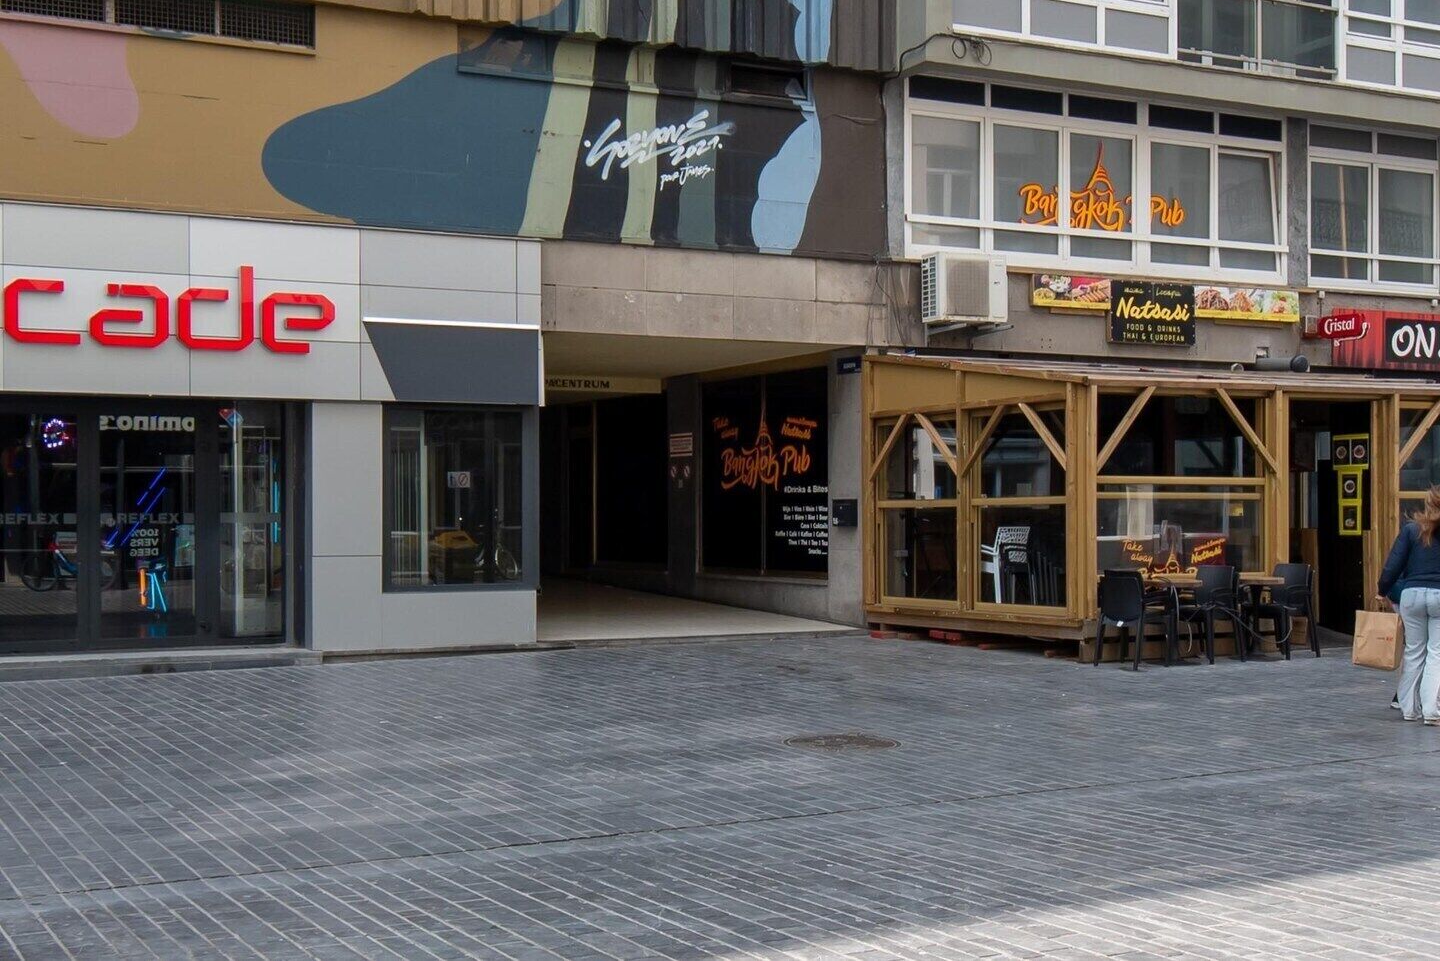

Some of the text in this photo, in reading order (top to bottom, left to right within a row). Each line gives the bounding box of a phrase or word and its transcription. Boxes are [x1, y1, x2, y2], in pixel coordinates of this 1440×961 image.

[3, 266, 336, 354] cade
[1116, 296, 1190, 322] Natsasi
[1126, 323, 1145, 331] FOOD
[1157, 325, 1181, 333] DRINKS
[1324, 317, 1355, 335] Cristal
[1149, 333, 1185, 342] EUROPEAN
[1391, 323, 1436, 358] ON
[721, 444, 812, 492] Bangkok Pub
[117, 512, 180, 525] REFLEX
[1122, 539, 1144, 552] Take
[1131, 552, 1154, 567] away
